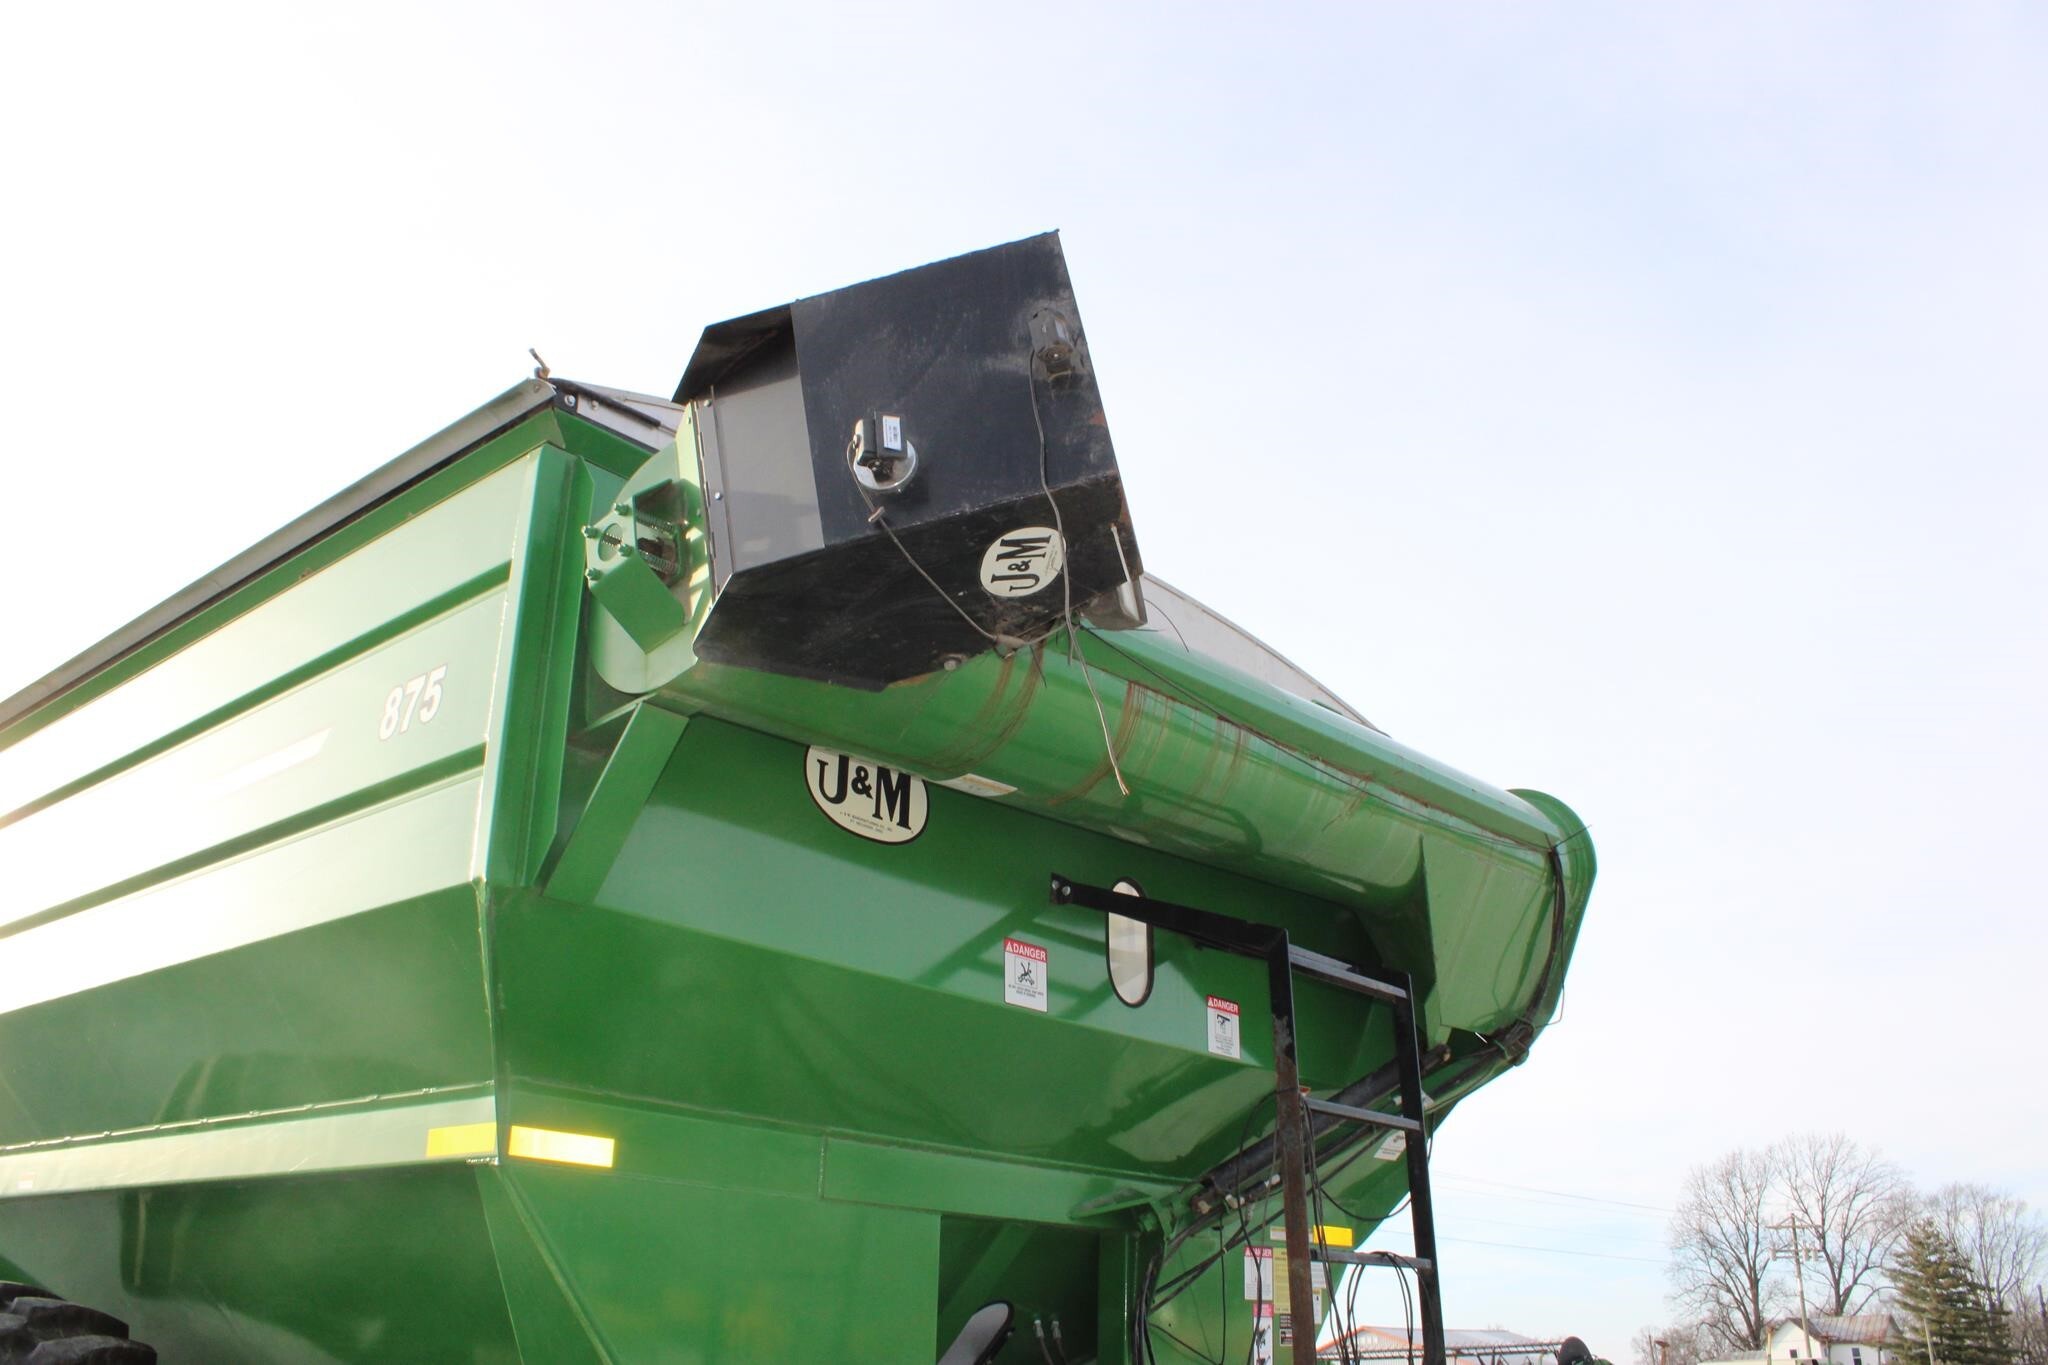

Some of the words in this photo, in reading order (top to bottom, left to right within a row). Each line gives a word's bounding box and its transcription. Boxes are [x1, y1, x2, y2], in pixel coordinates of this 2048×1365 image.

[991, 535, 1052, 592] J&M
[378, 662, 448, 741] 875
[816, 754, 912, 830] J&M
[1013, 943, 1046, 961] DANGER
[1213, 998, 1239, 1014] DANGER
